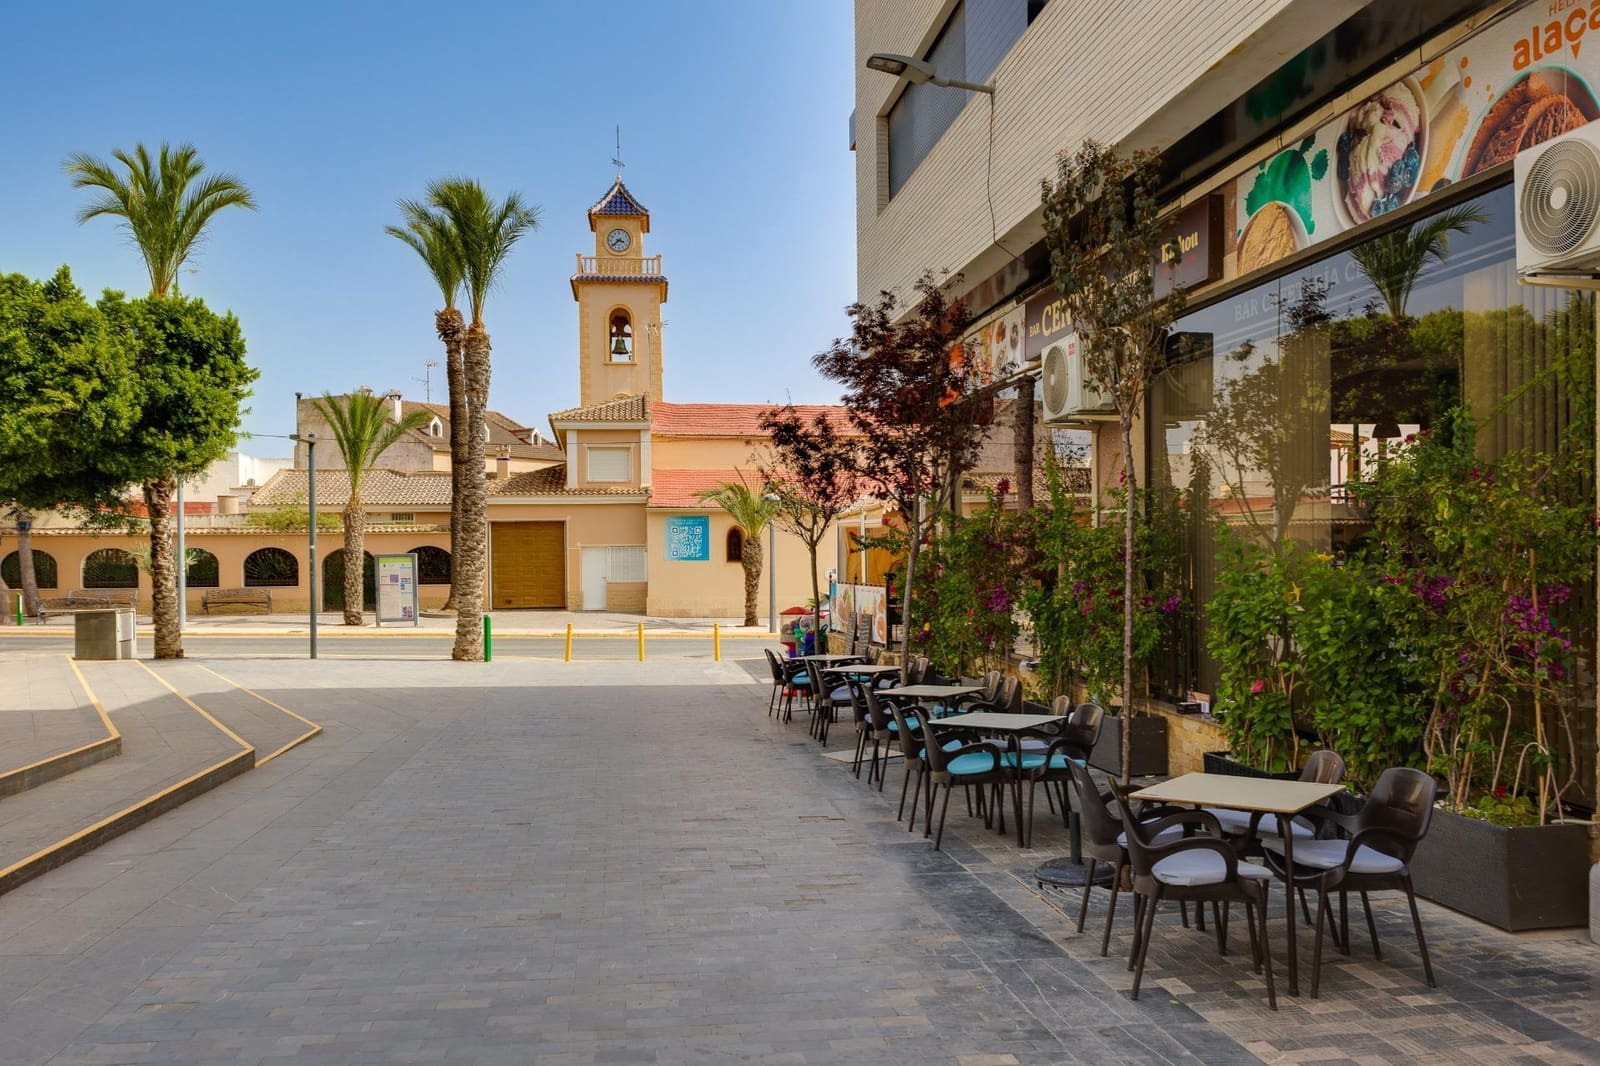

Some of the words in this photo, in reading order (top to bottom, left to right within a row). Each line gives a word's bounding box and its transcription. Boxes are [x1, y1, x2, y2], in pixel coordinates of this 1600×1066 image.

[1548, 0, 1577, 17] HEL
[1234, 298, 1259, 321] BAR
[1029, 322, 1041, 338] BAR
